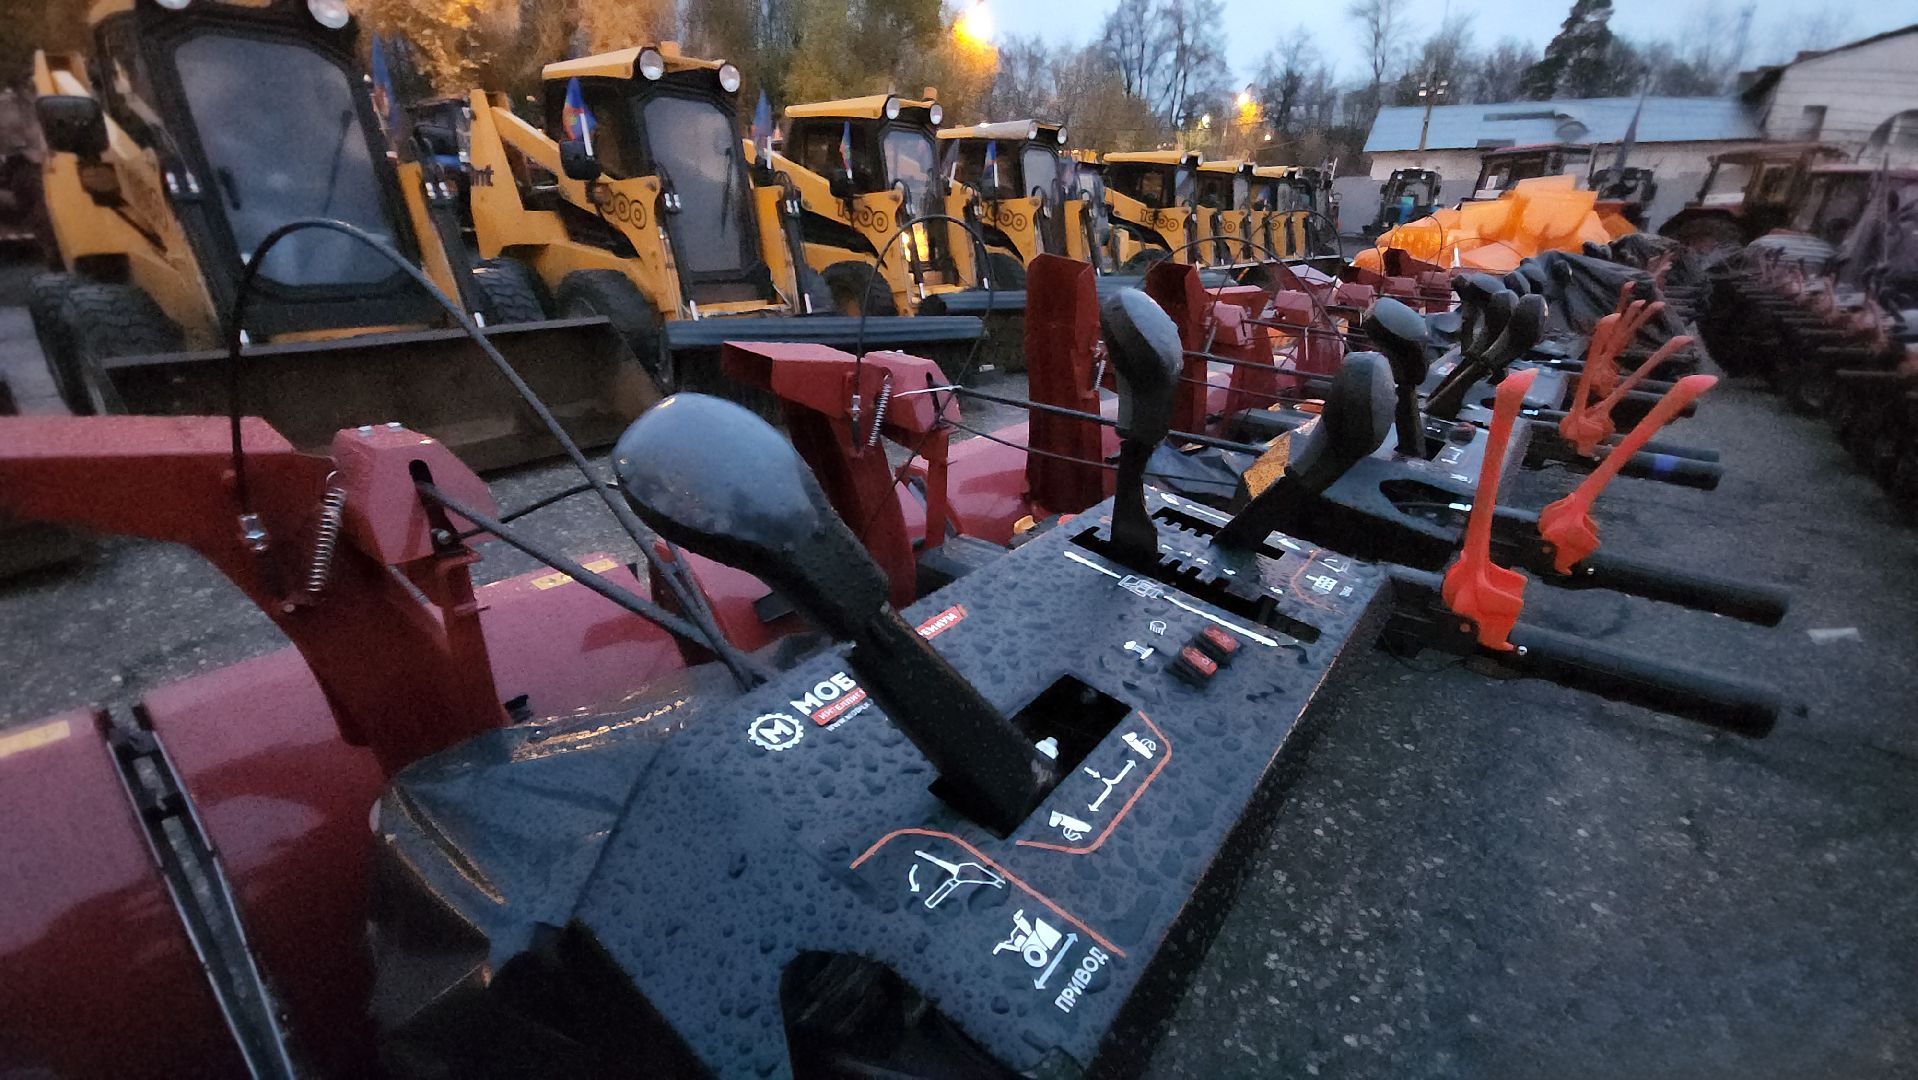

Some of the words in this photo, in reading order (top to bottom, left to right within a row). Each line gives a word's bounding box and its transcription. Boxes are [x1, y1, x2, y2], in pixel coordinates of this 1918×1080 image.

[919, 612, 958, 637] ЕМИУМ
[789, 671, 857, 717] МОБ
[1054, 946, 1109, 1013] ПРИВОД
